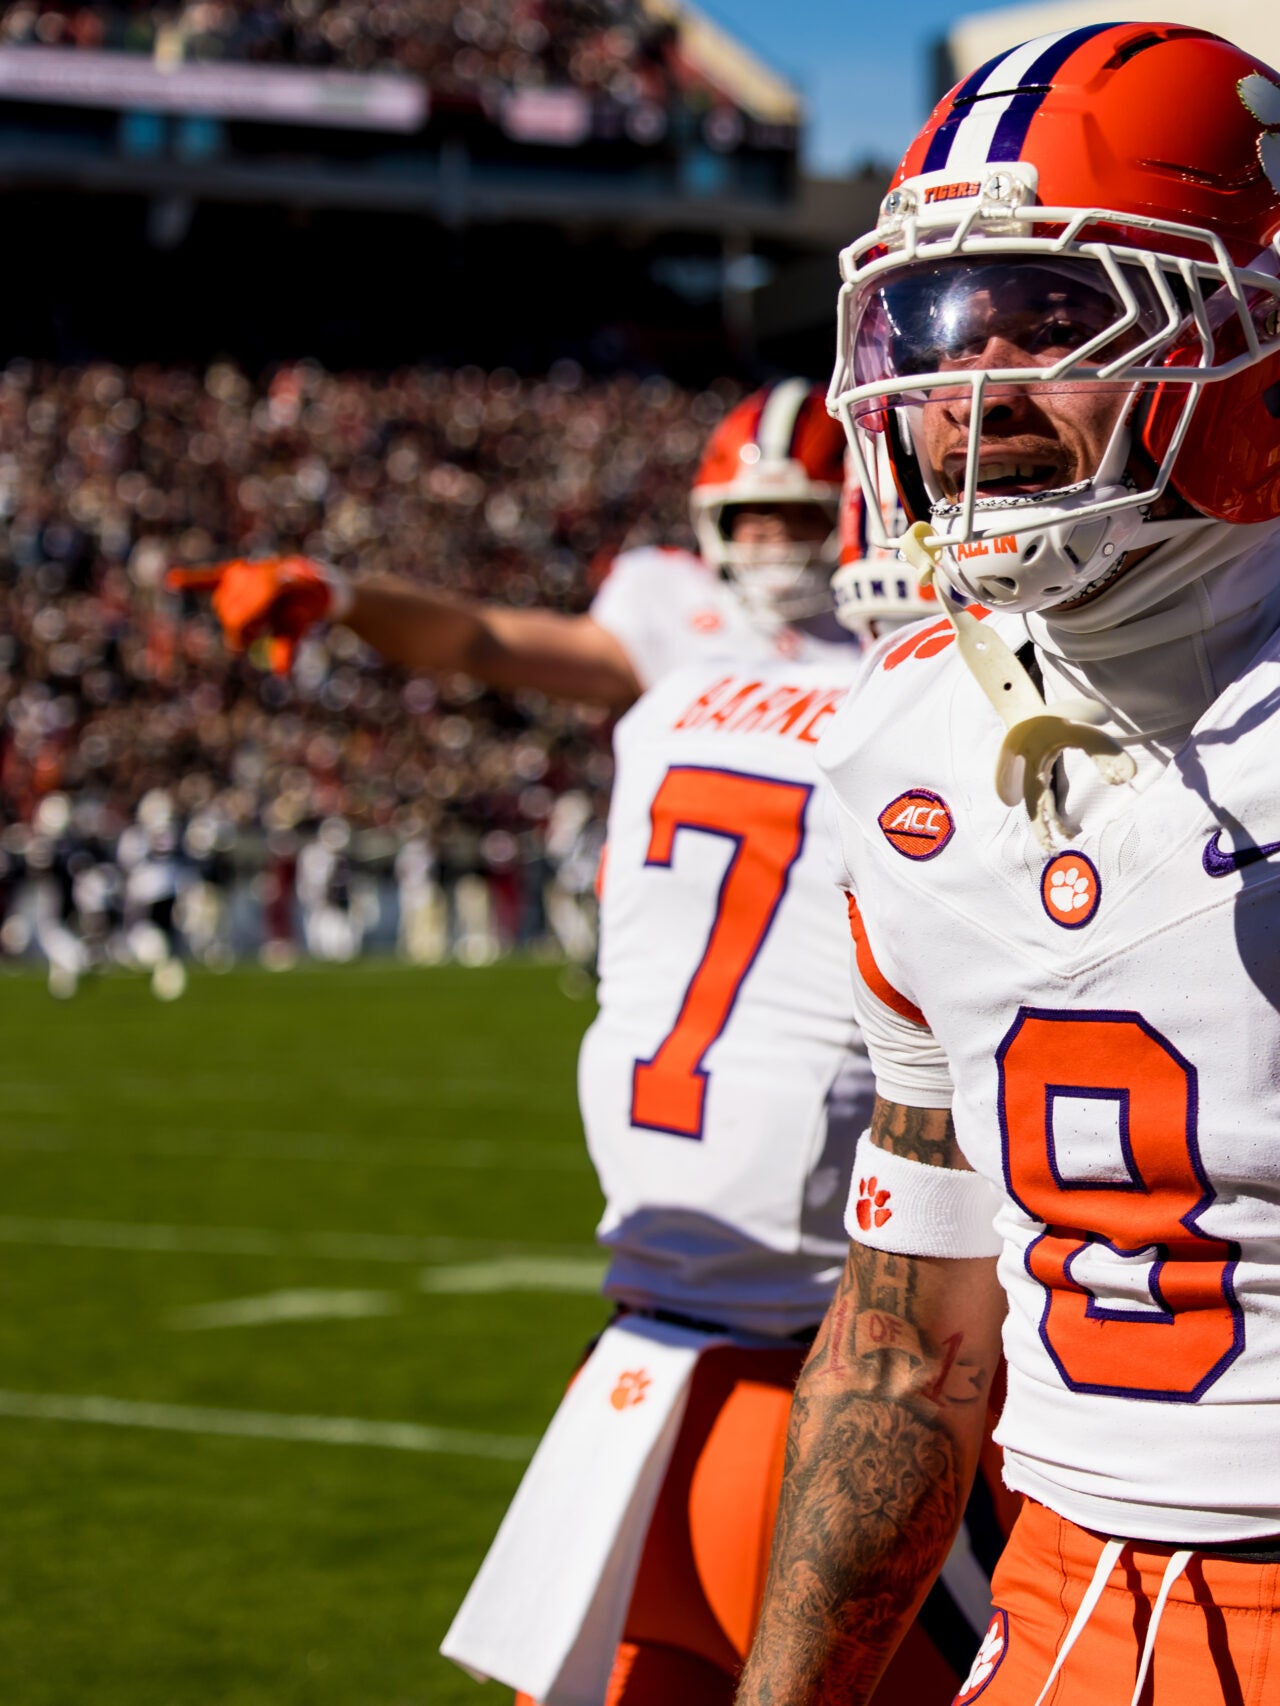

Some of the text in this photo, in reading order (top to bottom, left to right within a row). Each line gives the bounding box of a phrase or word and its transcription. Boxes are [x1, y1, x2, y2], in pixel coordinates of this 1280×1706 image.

[924, 181, 981, 204] TIGERS
[957, 534, 1018, 562] ALL IN
[889, 805, 946, 832] ACC
[630, 765, 815, 1140] 7
[995, 1006, 1246, 1404] 8
